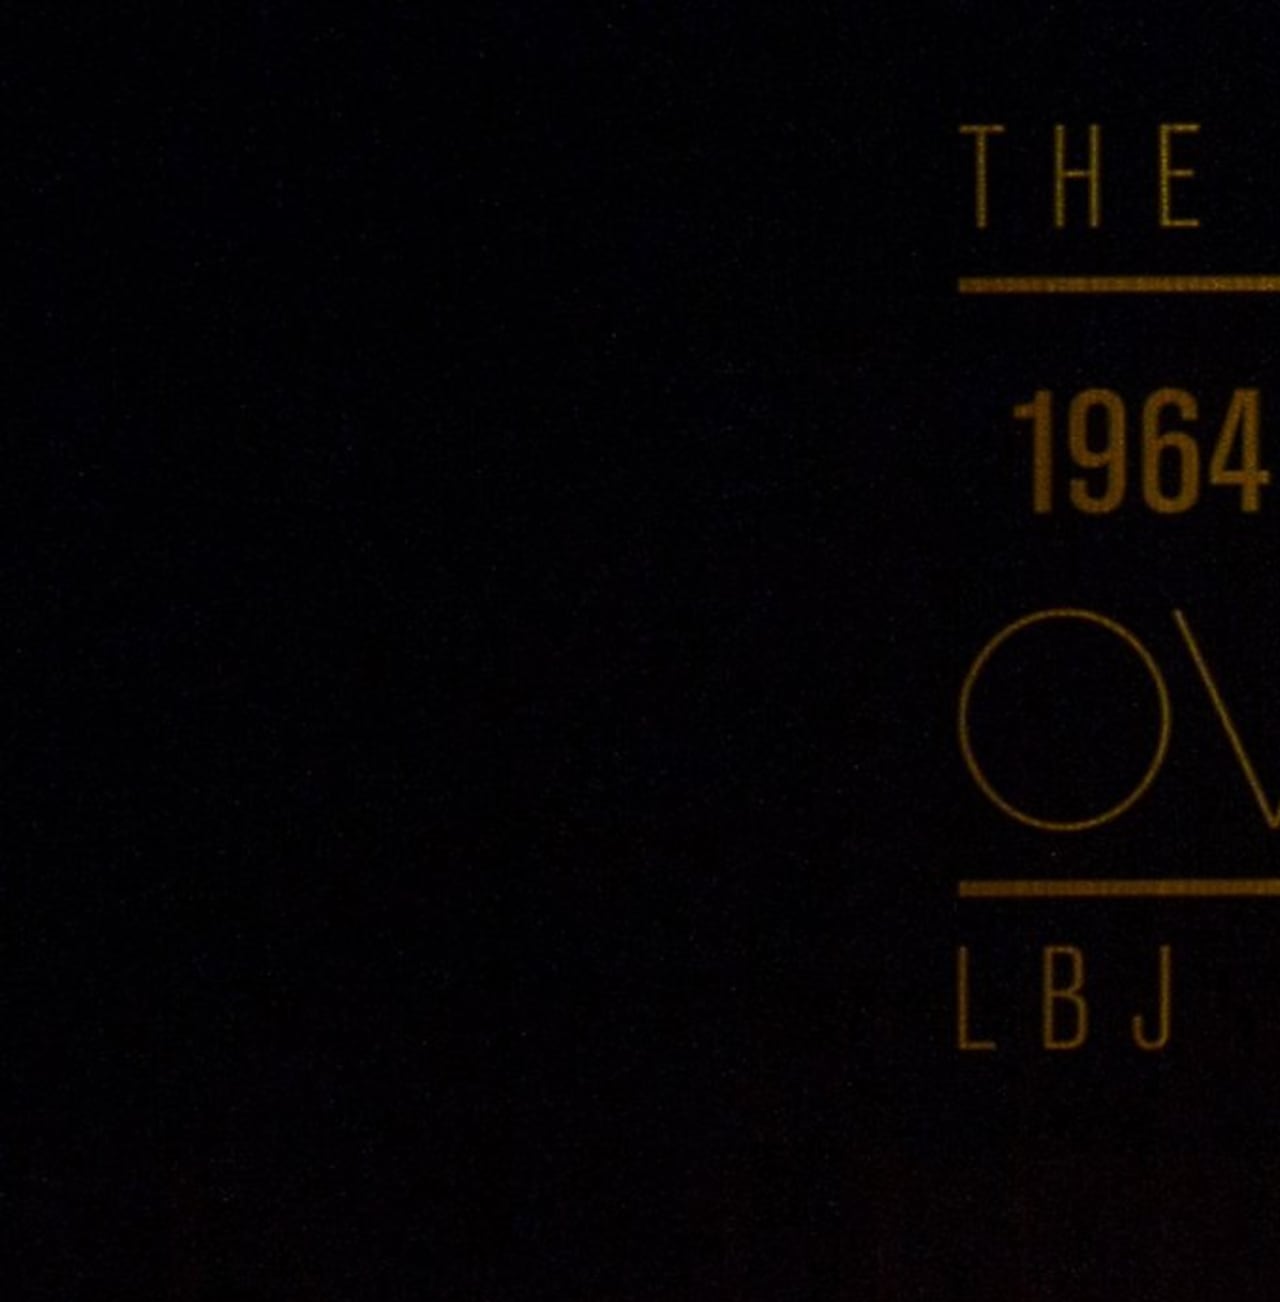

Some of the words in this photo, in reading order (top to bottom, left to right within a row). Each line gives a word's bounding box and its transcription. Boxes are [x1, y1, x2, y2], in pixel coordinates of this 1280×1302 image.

[958, 124, 1199, 227] THE
[1015, 388, 1269, 513] 1964
[959, 946, 1169, 1049] LBJ
